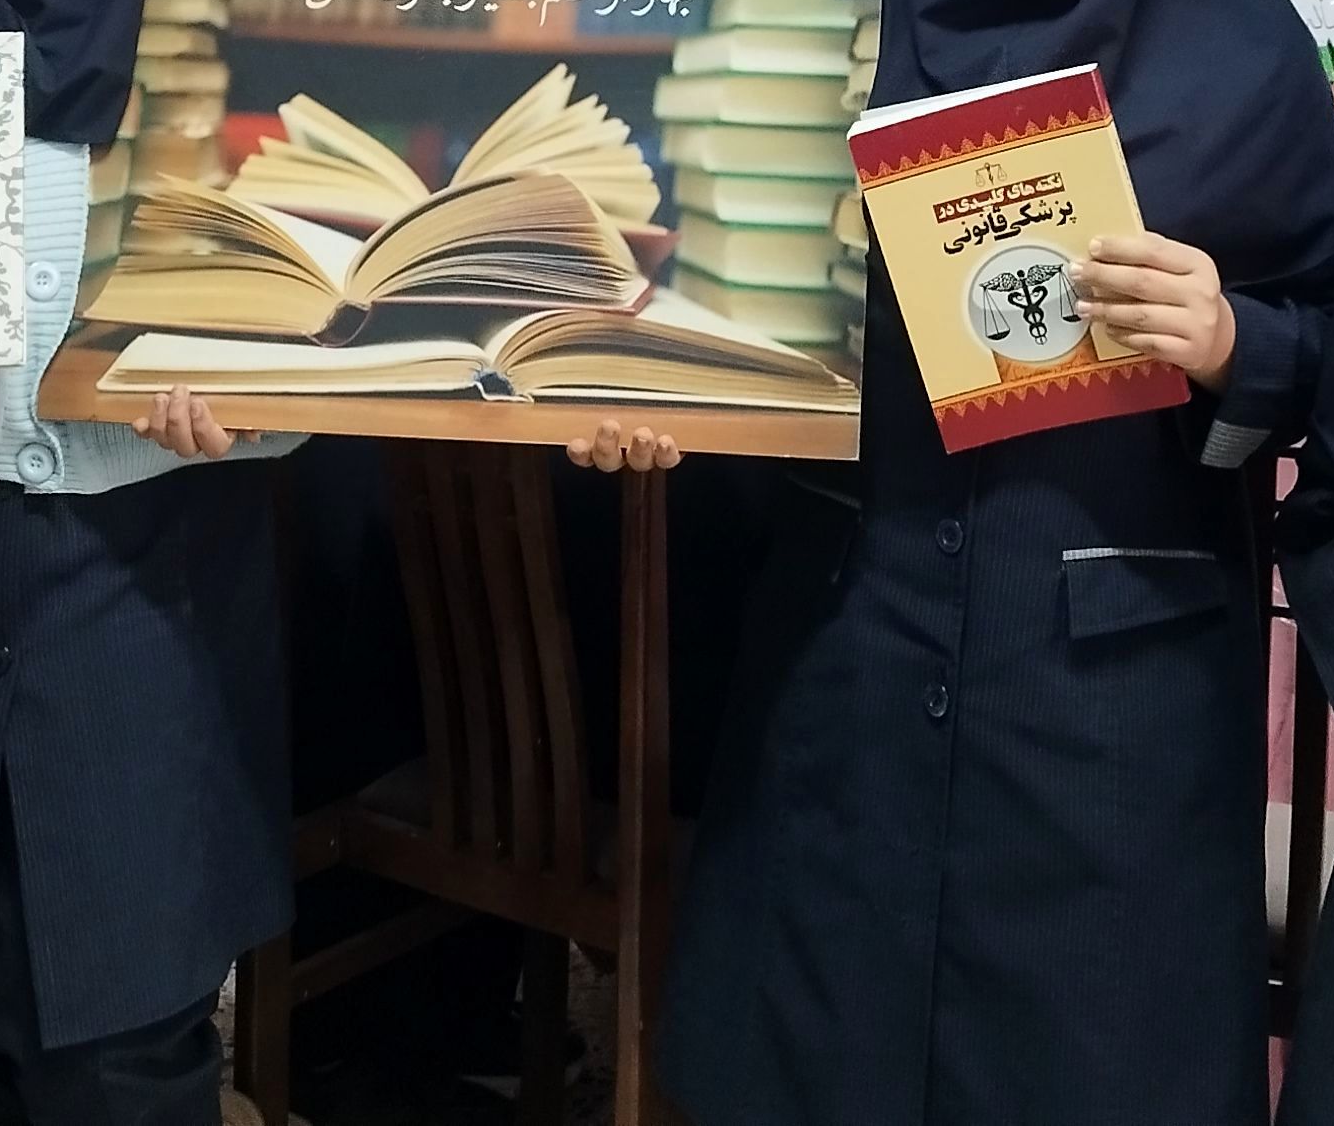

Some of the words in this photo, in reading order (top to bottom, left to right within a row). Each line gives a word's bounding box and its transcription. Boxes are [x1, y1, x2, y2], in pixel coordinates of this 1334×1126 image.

[1007, 182, 1036, 199] های
[1035, 173, 1063, 192] نکته
[955, 187, 1005, 213] کلیدی
[938, 203, 955, 220] در
[993, 199, 1077, 242] پزشکی
[943, 206, 1008, 255] قانونی
